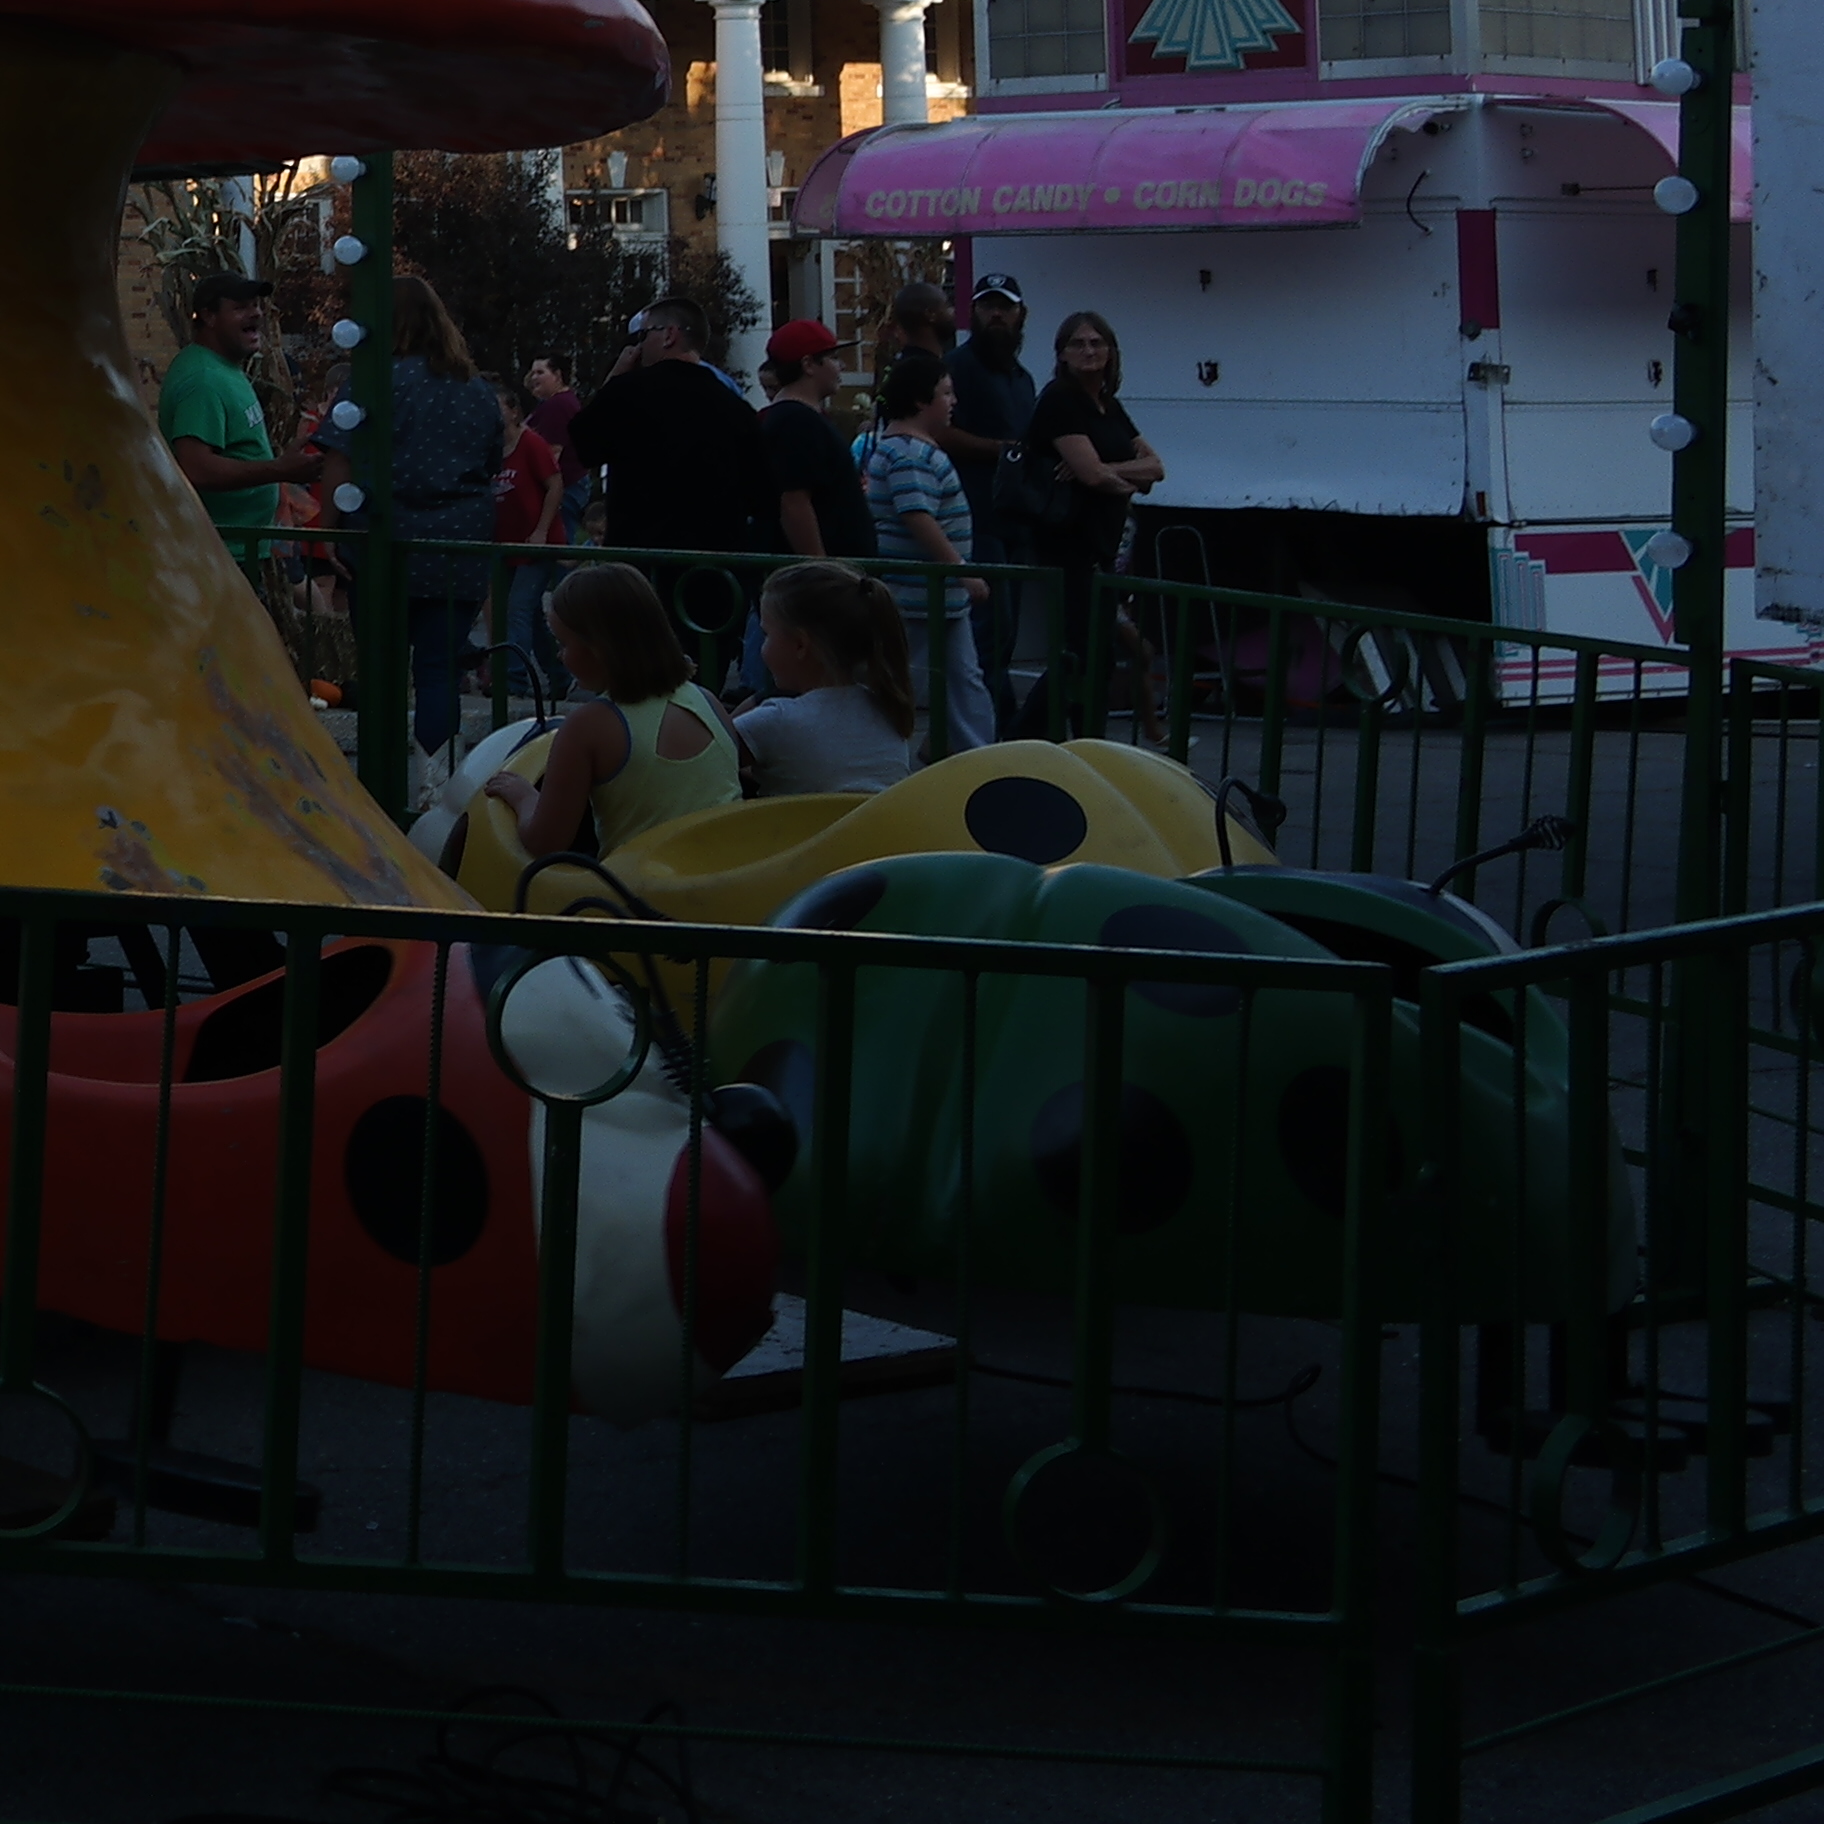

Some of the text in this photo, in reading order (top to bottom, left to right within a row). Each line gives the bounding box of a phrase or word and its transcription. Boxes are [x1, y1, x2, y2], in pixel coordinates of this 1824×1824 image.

[865, 176, 1329, 219] COTTON CANDY CORN DOGS
